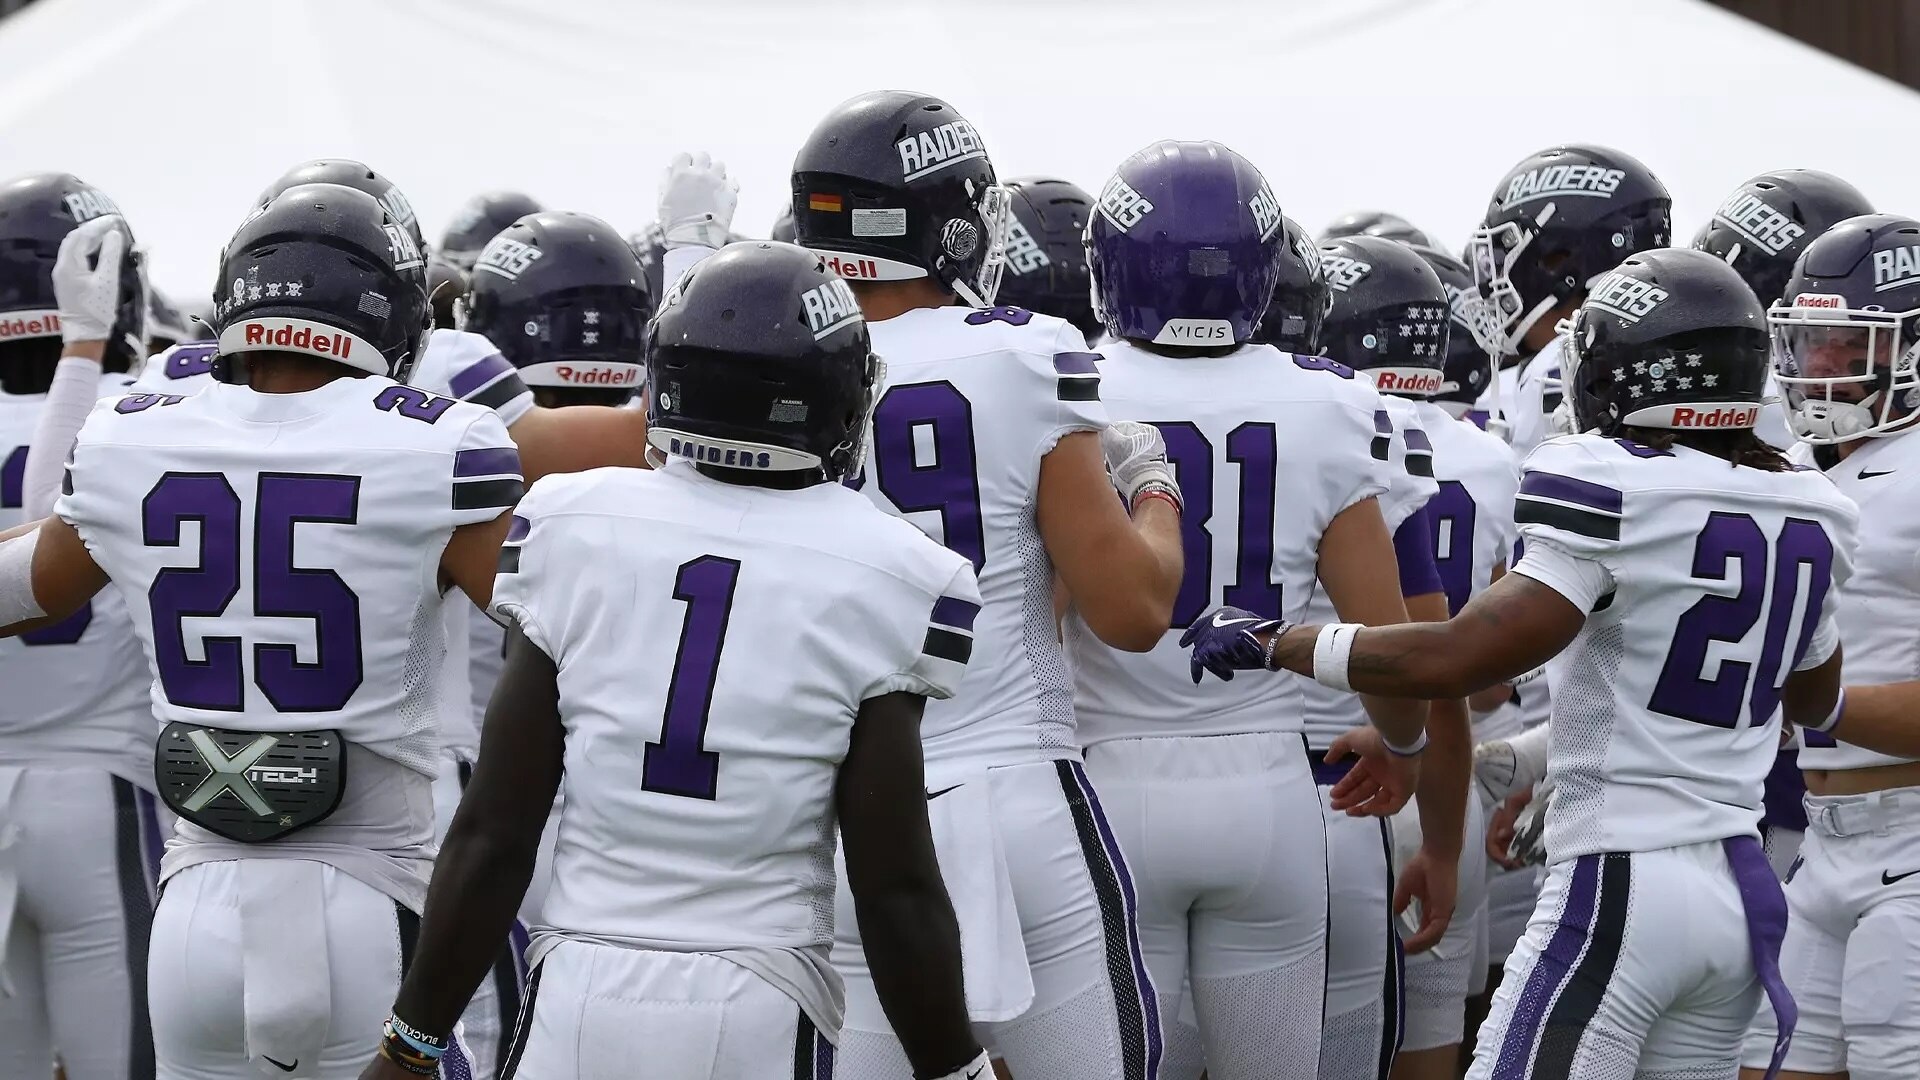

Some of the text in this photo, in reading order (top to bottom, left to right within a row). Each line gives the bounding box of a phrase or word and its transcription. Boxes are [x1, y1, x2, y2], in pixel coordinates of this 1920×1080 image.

[1504, 165, 1626, 204] RAIDERS
[1797, 296, 1839, 309] Riddell
[245, 323, 352, 360] Riddell
[1167, 324, 1227, 340] VICIS
[556, 366, 637, 385] Riddell
[1378, 372, 1442, 393] Riddell
[1671, 407, 1758, 428] Riddell
[669, 437, 771, 469] RAIDERS
[142, 471, 364, 713] 25
[1648, 511, 1835, 730] 20
[641, 554, 742, 802] 1
